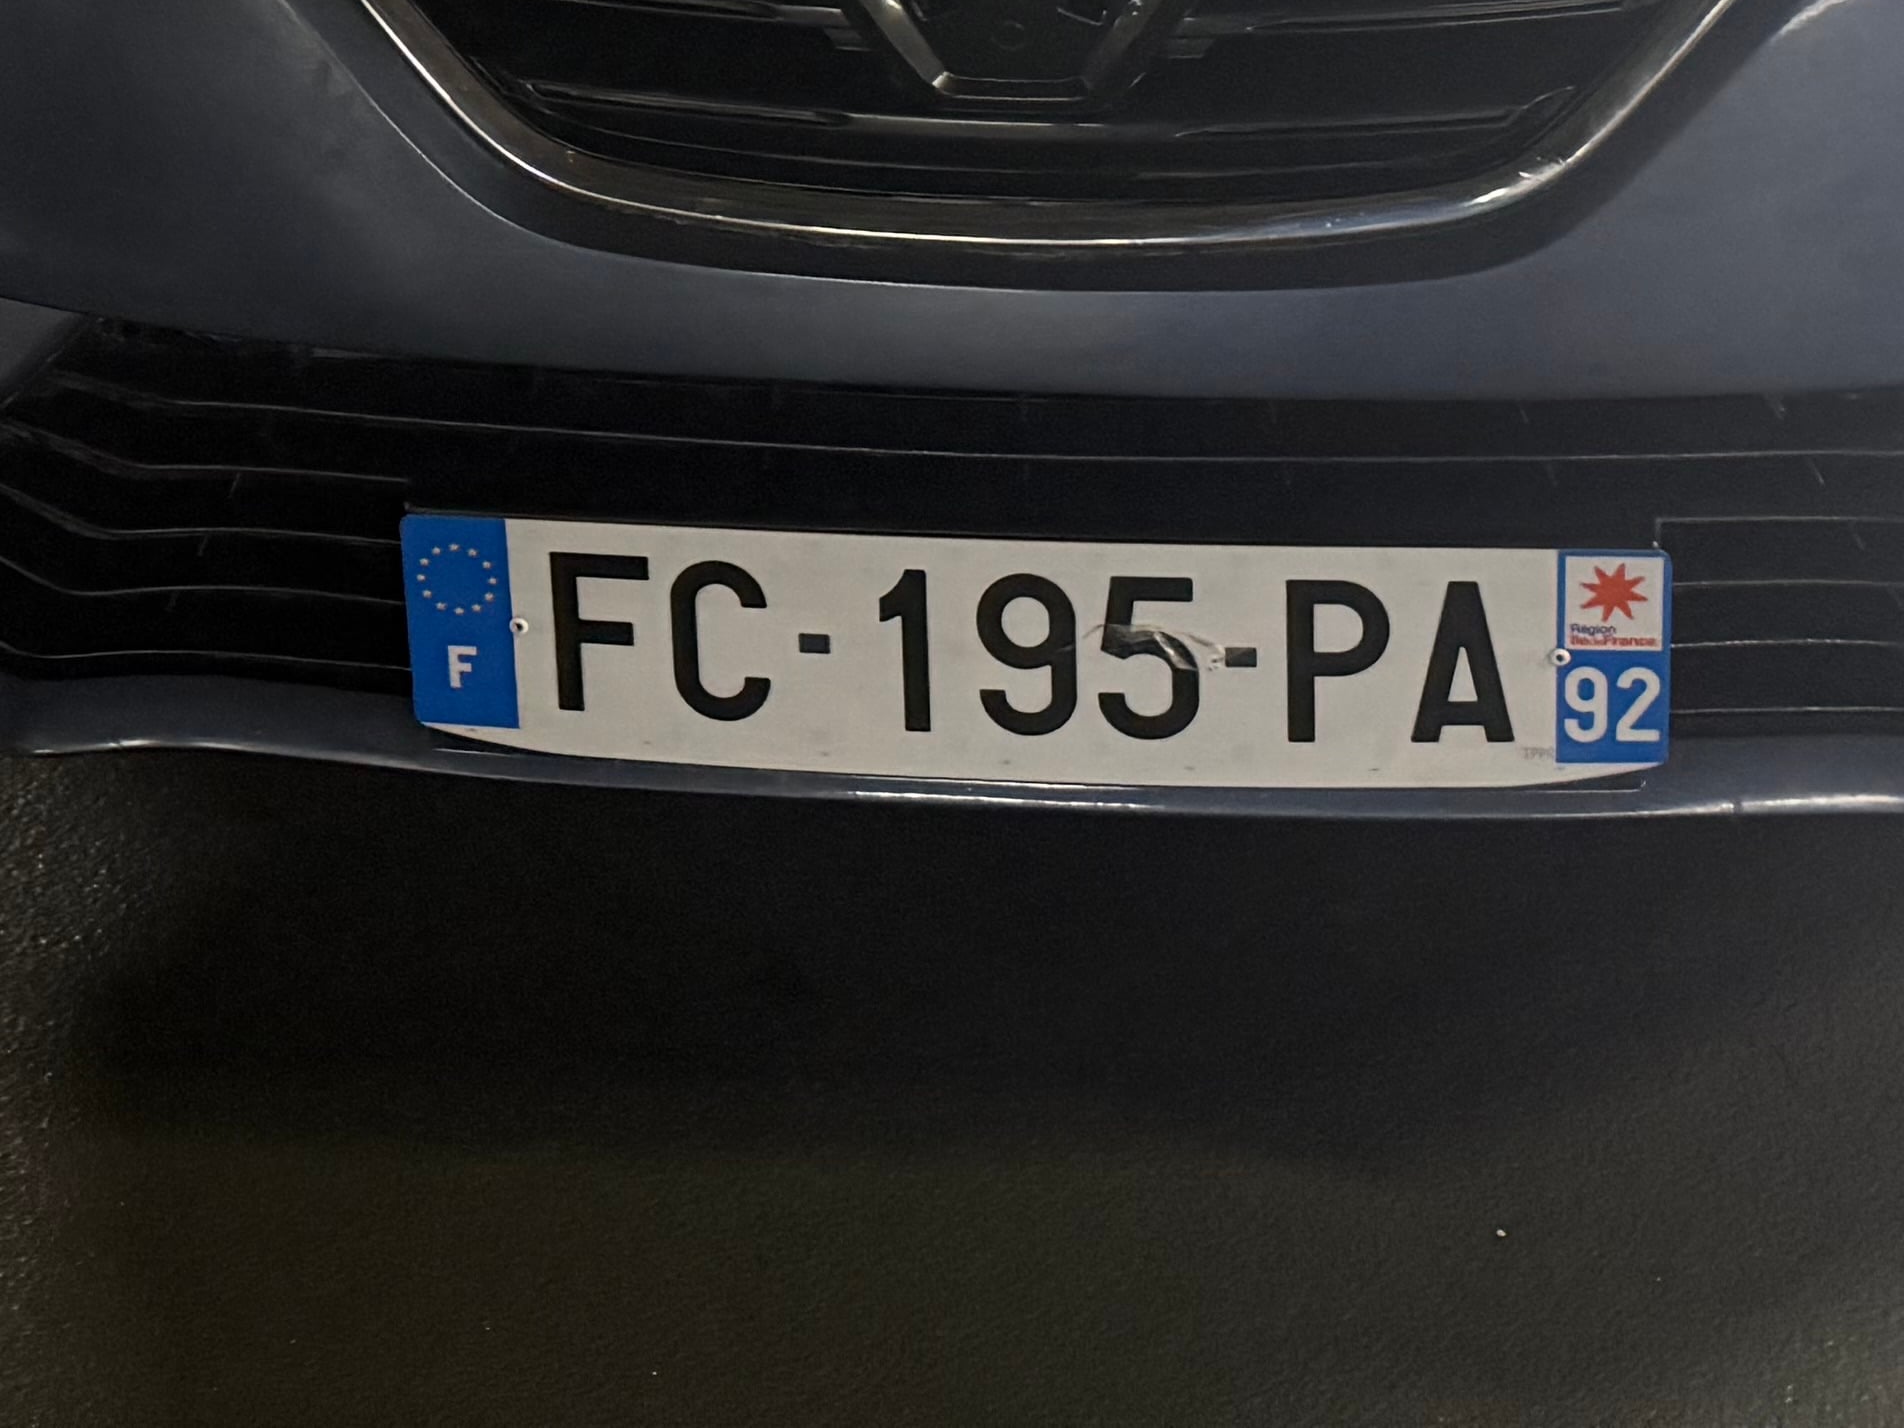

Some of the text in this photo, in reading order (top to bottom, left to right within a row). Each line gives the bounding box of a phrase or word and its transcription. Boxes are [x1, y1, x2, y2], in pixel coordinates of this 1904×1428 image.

[447, 645, 478, 688] F
[548, 551, 1516, 744] FC-195-PA
[1564, 666, 1661, 743] 92
